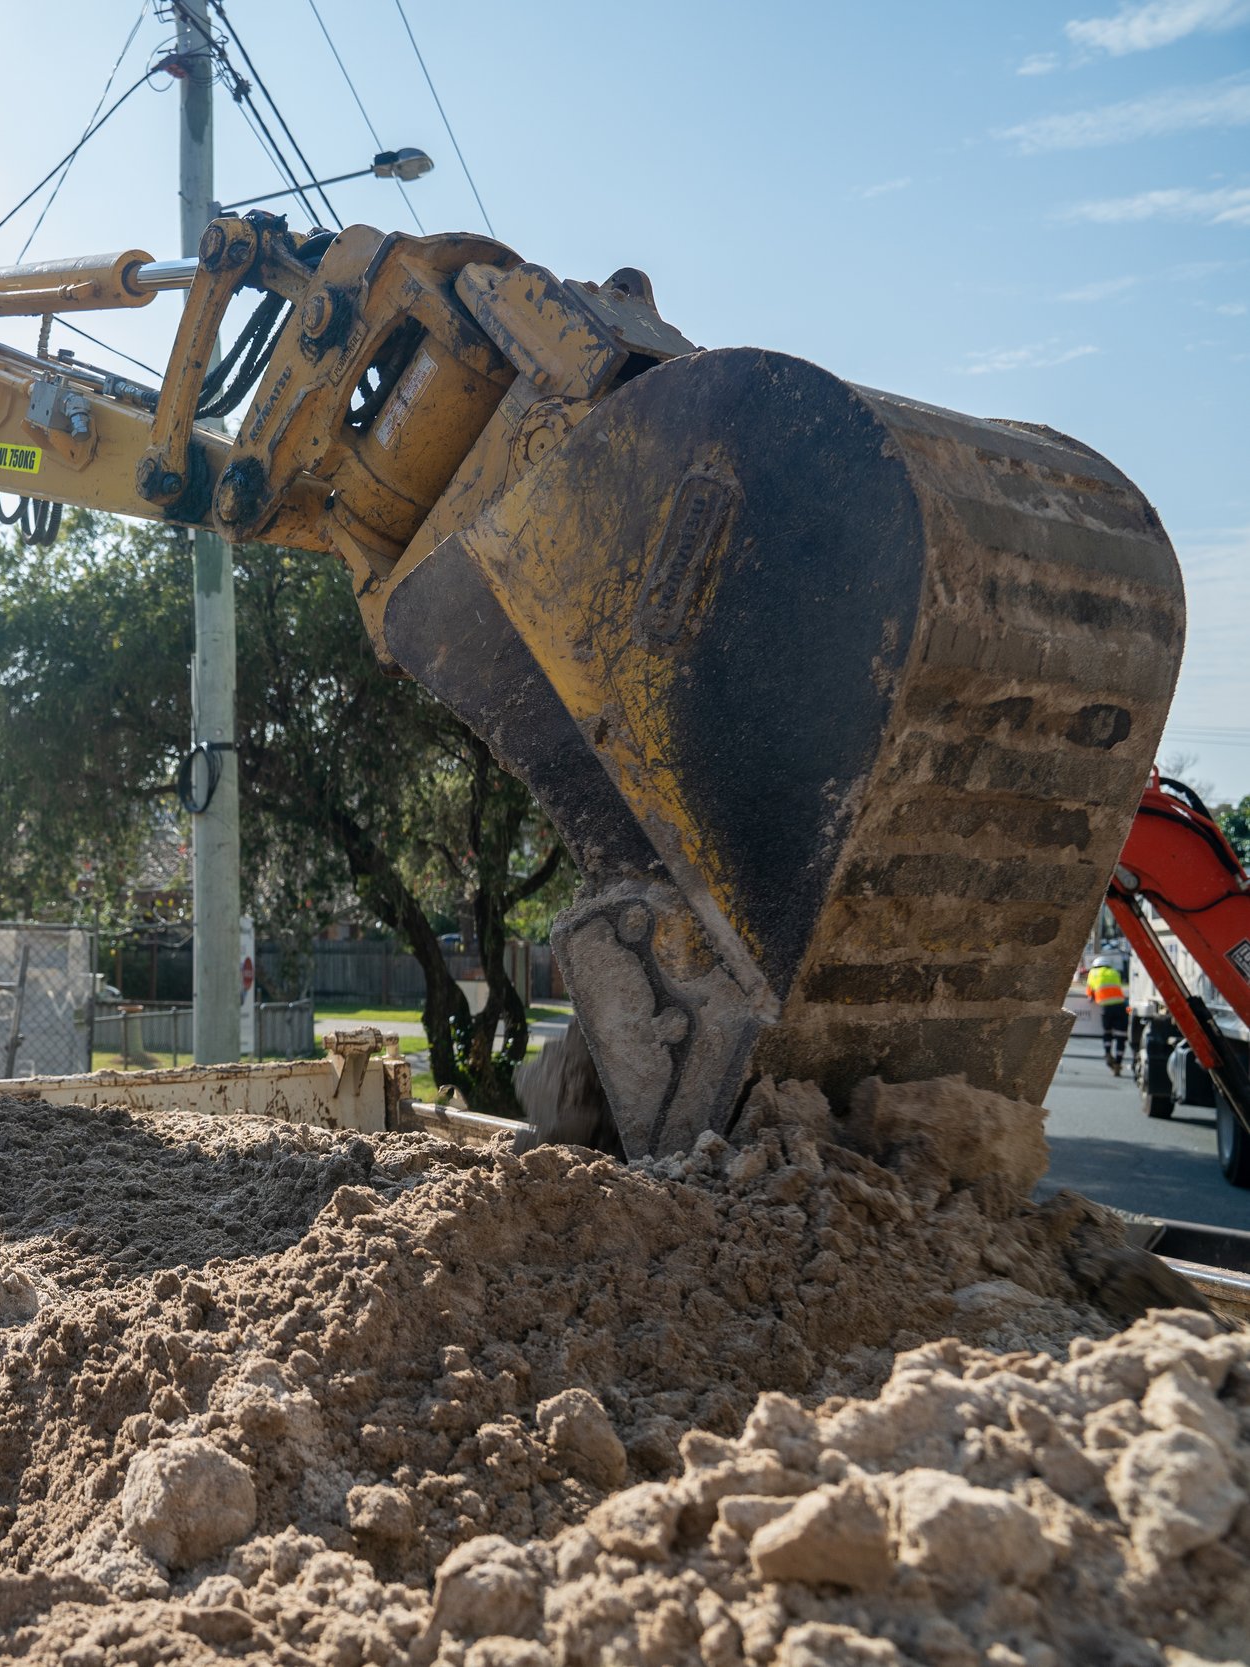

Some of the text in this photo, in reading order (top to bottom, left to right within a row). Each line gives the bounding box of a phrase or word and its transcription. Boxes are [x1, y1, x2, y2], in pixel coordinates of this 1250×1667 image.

[250, 365, 292, 441] KOMATSU
[8, 448, 36, 470] 750KG
[655, 496, 707, 612] OMATSU
